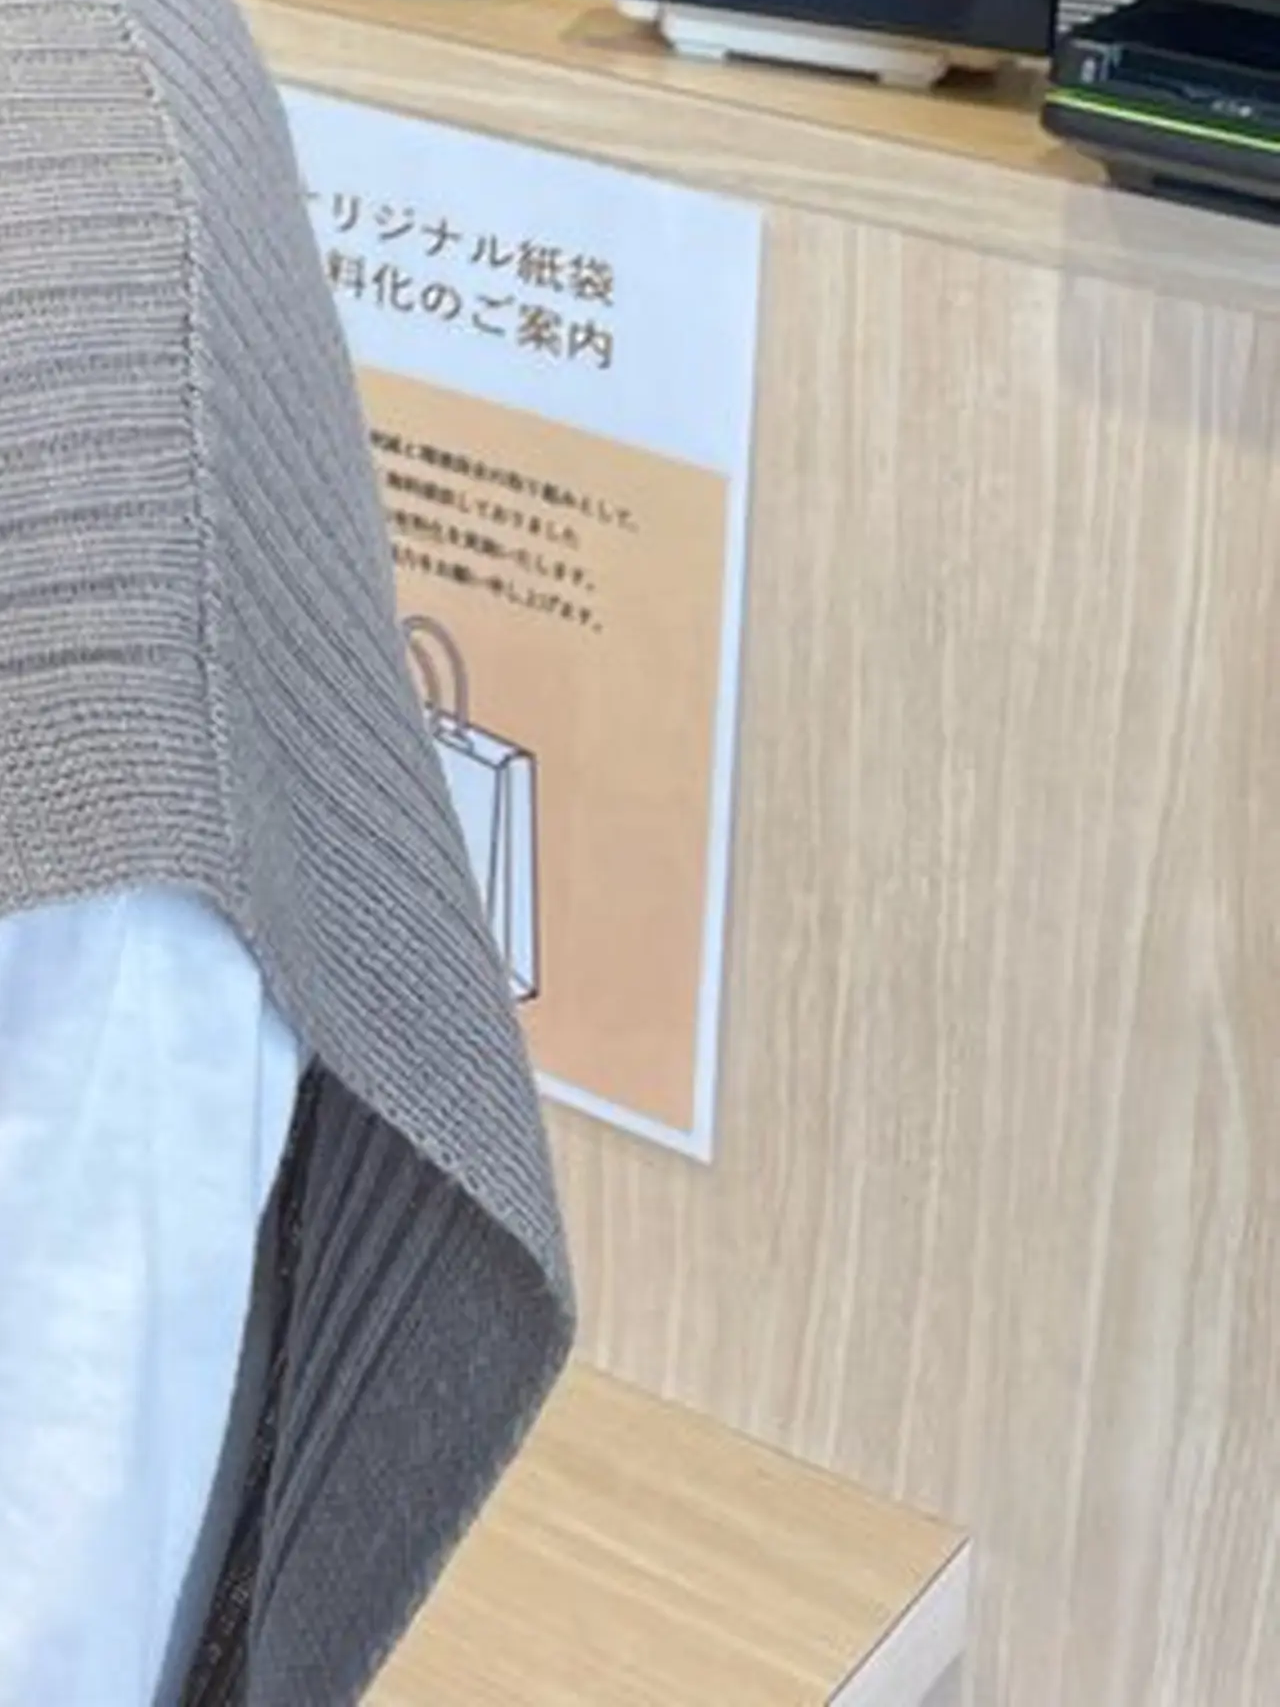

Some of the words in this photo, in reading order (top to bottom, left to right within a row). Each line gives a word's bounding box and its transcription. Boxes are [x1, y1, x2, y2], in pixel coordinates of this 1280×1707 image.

[304, 190, 615, 307] リジナル紙袋
[326, 247, 615, 370] 料化のご案内
